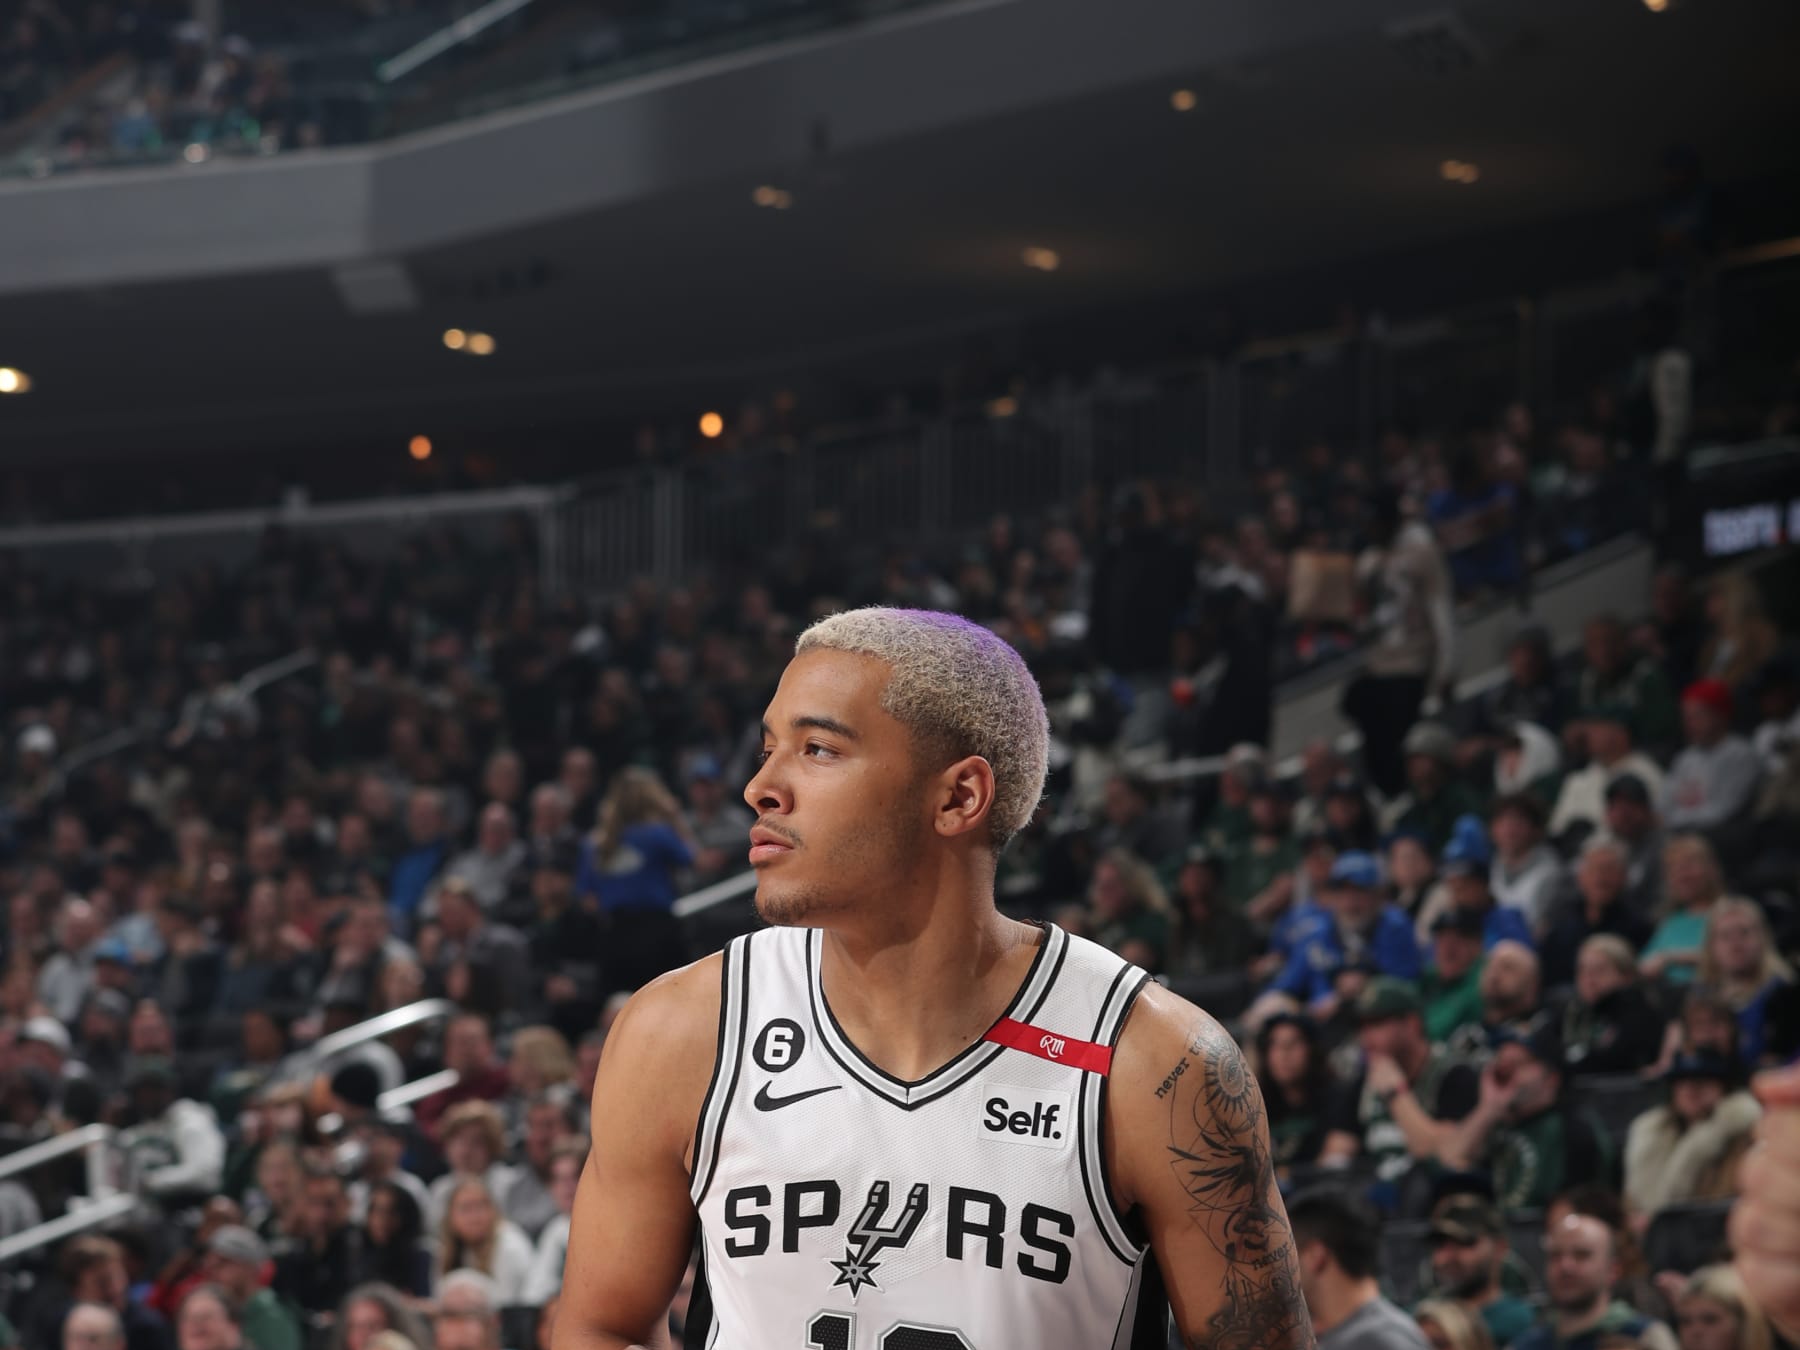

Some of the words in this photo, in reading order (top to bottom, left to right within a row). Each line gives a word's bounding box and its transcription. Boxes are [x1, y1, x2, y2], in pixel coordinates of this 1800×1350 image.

[763, 1027, 794, 1066] 6
[1155, 1057, 1190, 1099] never
[984, 1097, 1062, 1140] Self.
[724, 1179, 1076, 1302] SPURS
